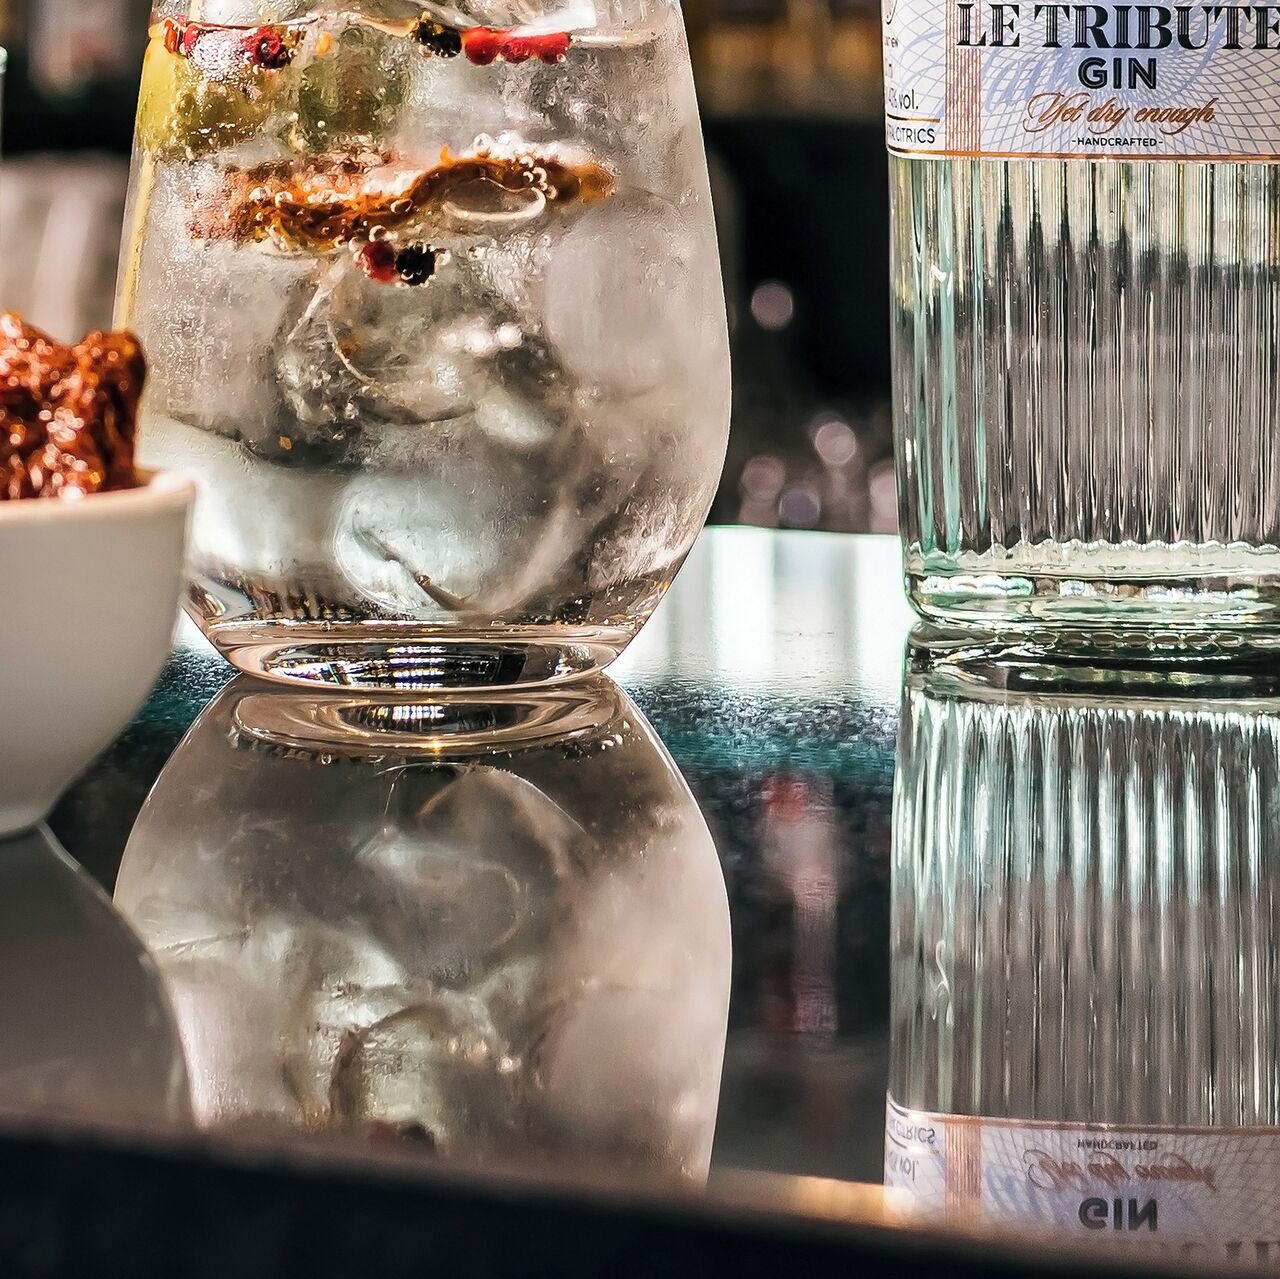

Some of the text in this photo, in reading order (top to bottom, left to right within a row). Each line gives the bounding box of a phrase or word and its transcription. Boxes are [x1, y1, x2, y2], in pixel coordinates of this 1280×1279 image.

[955, 3, 1021, 48] LE
[1076, 57, 1158, 90] GIN
[1023, 91, 1220, 135] Yet dry enough
